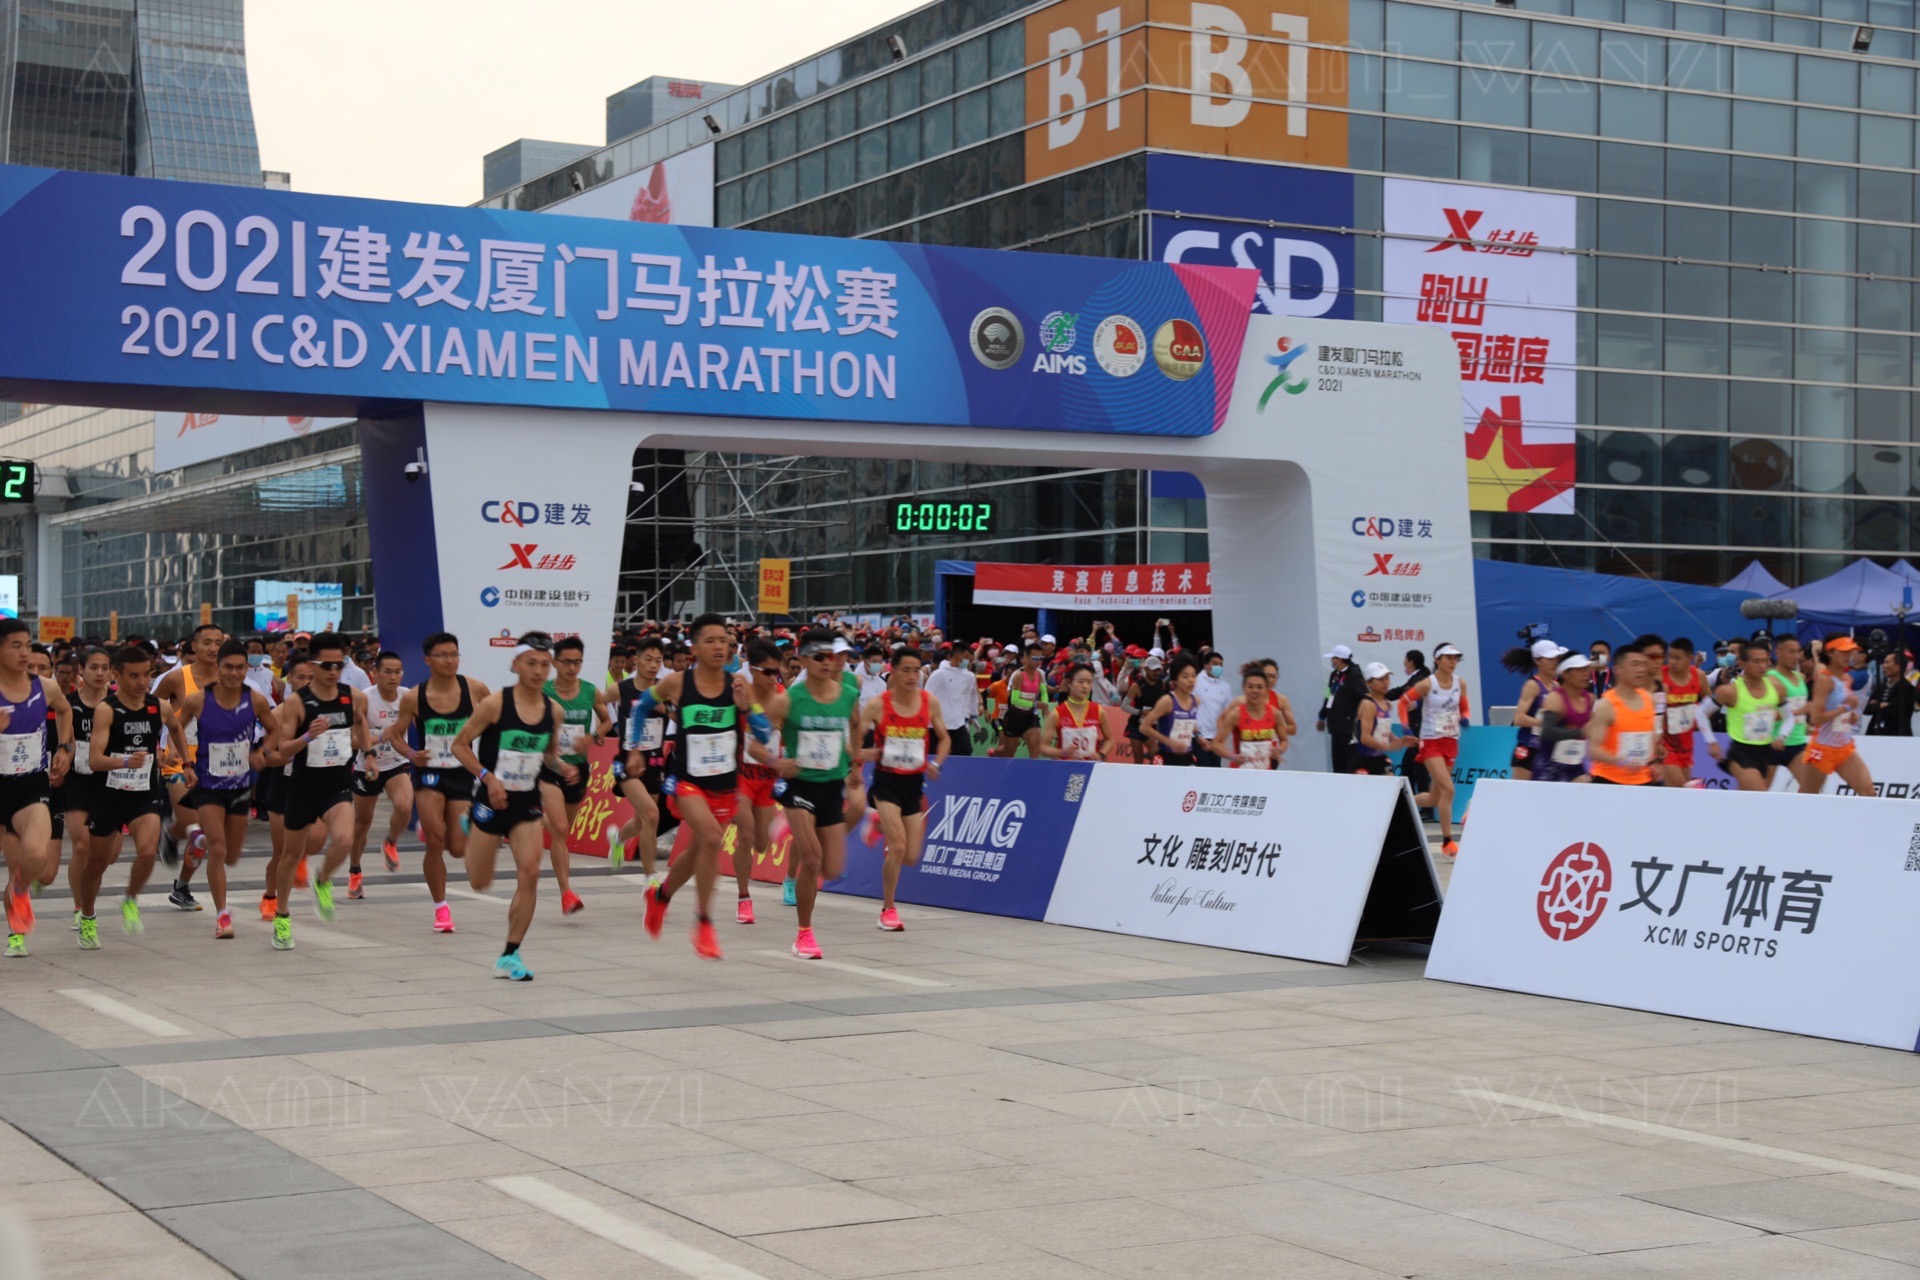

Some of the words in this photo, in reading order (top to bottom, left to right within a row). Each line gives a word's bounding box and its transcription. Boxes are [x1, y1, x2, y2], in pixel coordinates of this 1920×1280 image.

[1048, 7, 1121, 150] B1
[1190, 2, 1308, 137] B1
[120, 205, 899, 339] 2021建发厦门马拉松赛
[1417, 273, 1488, 326] 跑出
[121, 305, 237, 361] 2021
[251, 314, 368, 369] C&D
[381, 322, 599, 385] XIAMEN
[619, 339, 896, 400] MARATHON
[1033, 353, 1087, 375] AIMS
[1172, 344, 1202, 357] CAA
[1318, 345, 1403, 367] 建发厦门马拉松
[1318, 365, 1336, 375] C&D
[1337, 367, 1371, 378] XIAMEN
[1374, 369, 1421, 381] MARATHON
[1318, 378, 1343, 392] 2021
[481, 500, 540, 528] C&D
[544, 503, 591, 526] 建发
[897, 504, 991, 531] 0:00:02
[1352, 516, 1395, 540] C&D
[1398, 519, 1433, 538] 建发
[505, 589, 591, 602] 中国建设银行
[1369, 592, 1432, 603] 中国建设银行
[1384, 629, 1425, 641] 青岛啤酒
[124, 721, 152, 735] CHINA
[1198, 792, 1267, 810] 厦门文广传媒集团
[927, 794, 1026, 848] XMG
[923, 844, 1007, 871] 厦门广播电视集团
[1137, 833, 1184, 868] 文化
[1186, 837, 1282, 878] 雕刻时代
[920, 864, 949, 877] XIAMEN
[948, 867, 972, 879] MEDIA
[972, 871, 1000, 882] GROUP
[1150, 877, 1177, 905] Value
[1167, 887, 1193, 917] for
[1193, 889, 1238, 912] Culture
[1619, 856, 1833, 934] 文广体育
[1644, 925, 1687, 947] XCM
[1693, 930, 1778, 958] SPORTS
